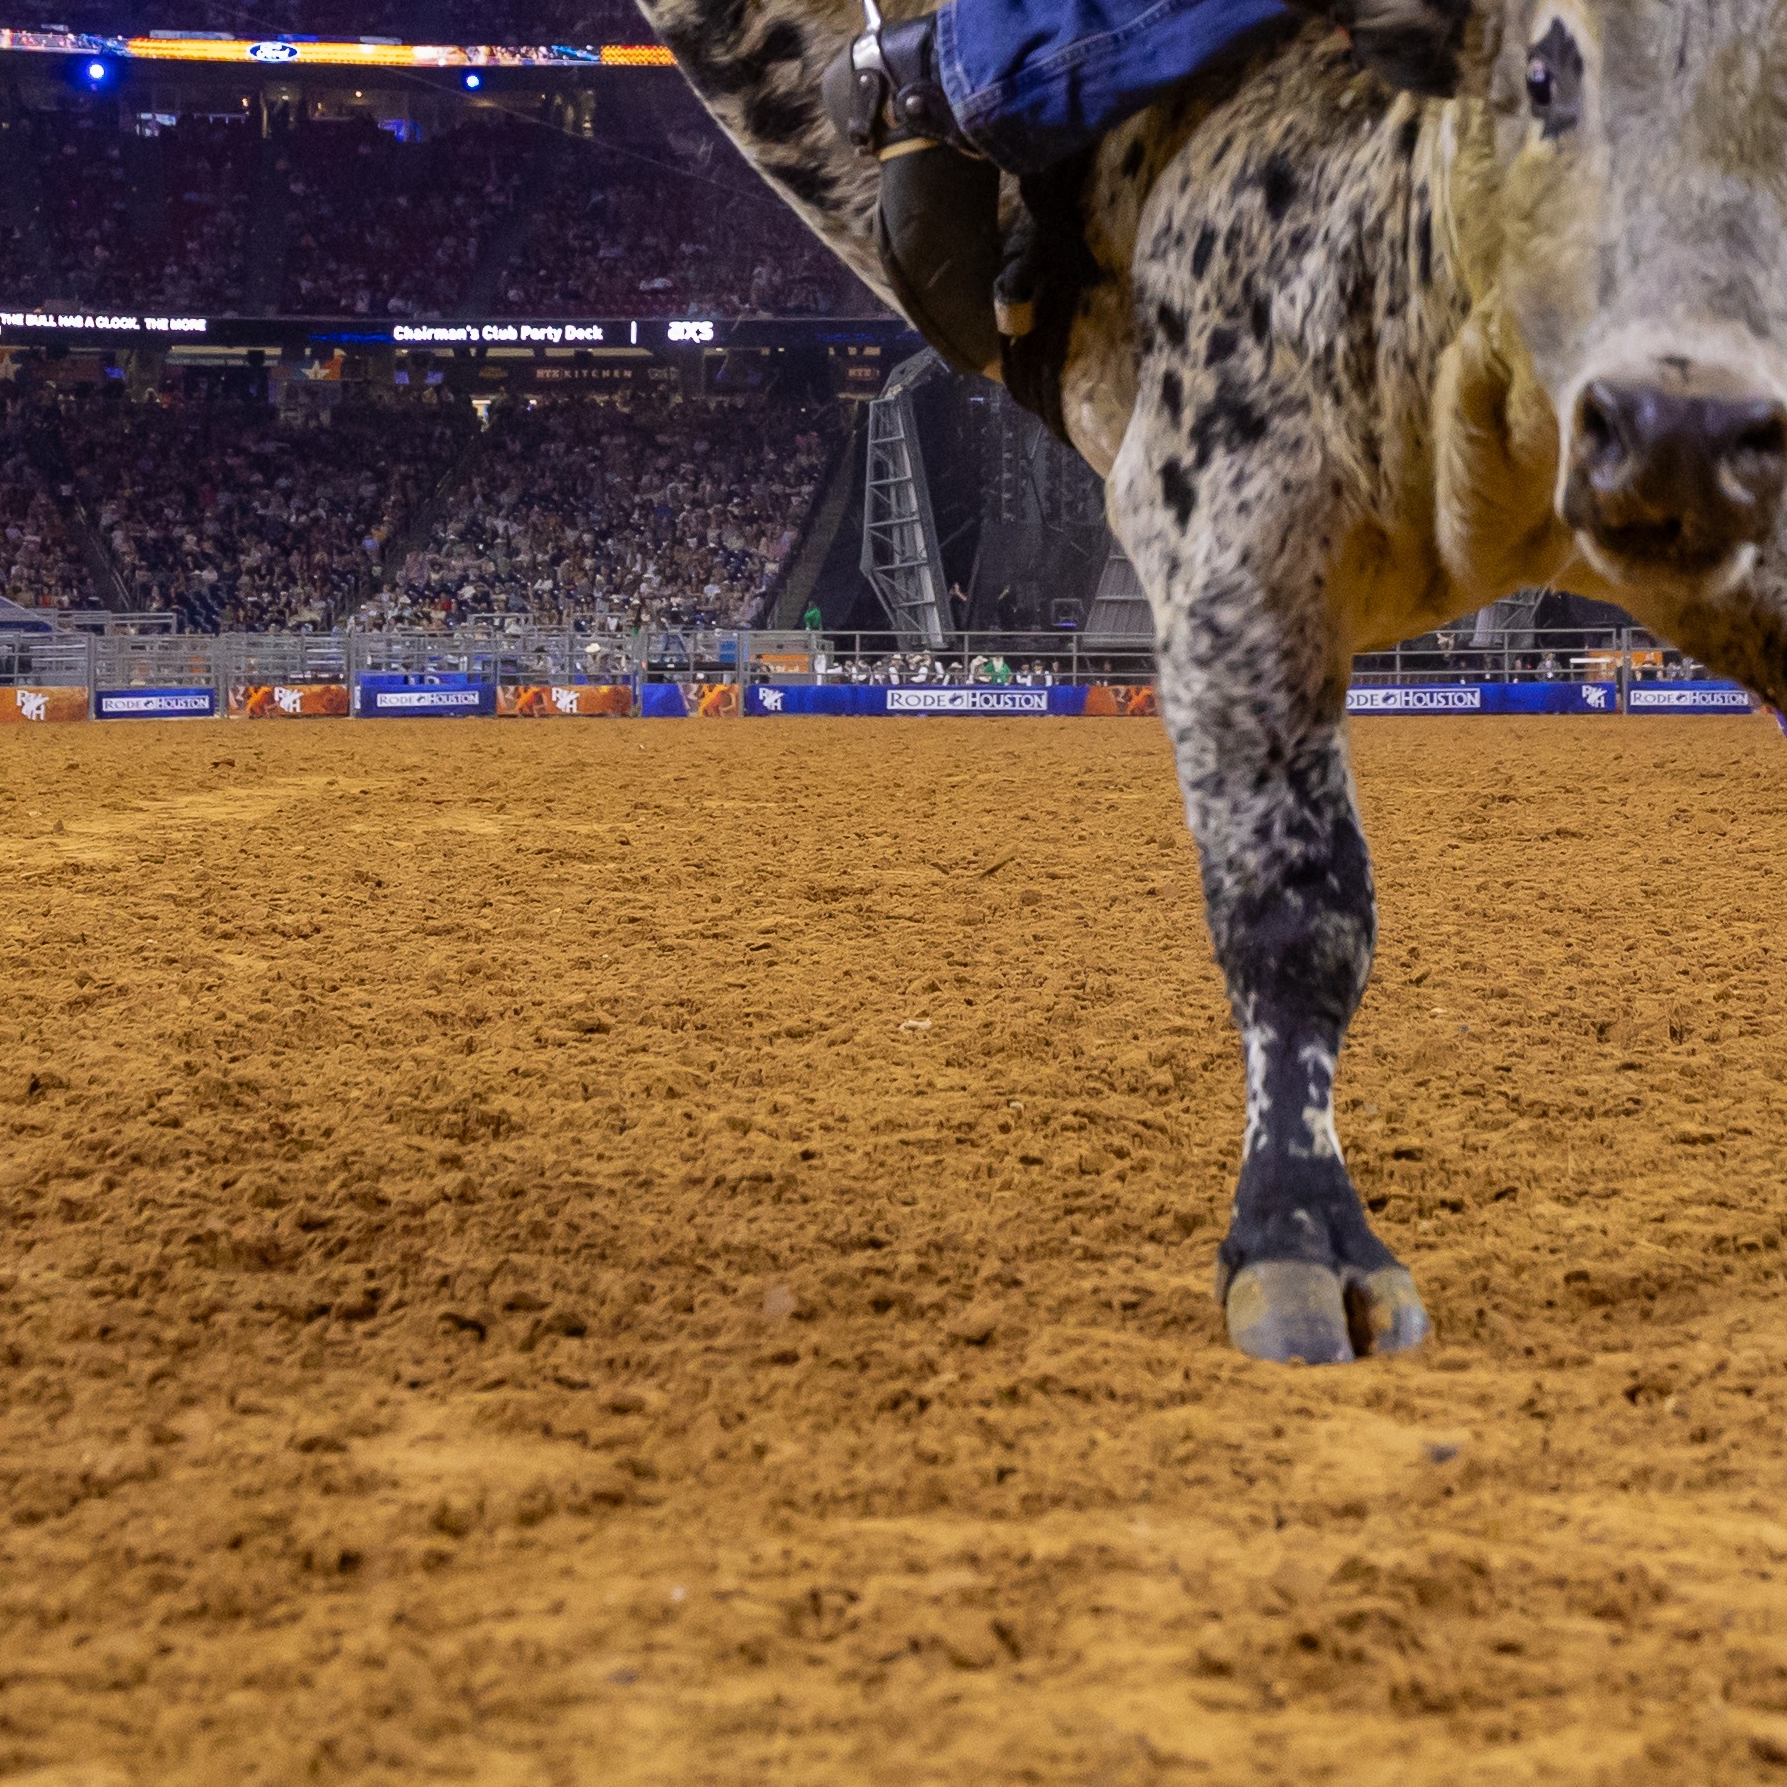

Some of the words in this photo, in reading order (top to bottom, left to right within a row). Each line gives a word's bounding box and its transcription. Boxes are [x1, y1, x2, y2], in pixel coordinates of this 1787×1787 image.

[393, 324, 480, 341] Chairman's
[482, 325, 518, 341] Club
[520, 325, 563, 343] Party
[564, 325, 604, 341] Deck
[104, 698, 155, 710] RODEO
[157, 696, 209, 710] HOUSTON
[379, 693, 426, 705] RODEO
[428, 691, 478, 704] HOUSTON
[890, 690, 965, 707] RODEO
[969, 691, 1046, 709] HOUSTON
[1401, 689, 1479, 708] HOUSTON
[1633, 691, 1688, 704] RODEO
[1691, 691, 1748, 705] HOUSTON
